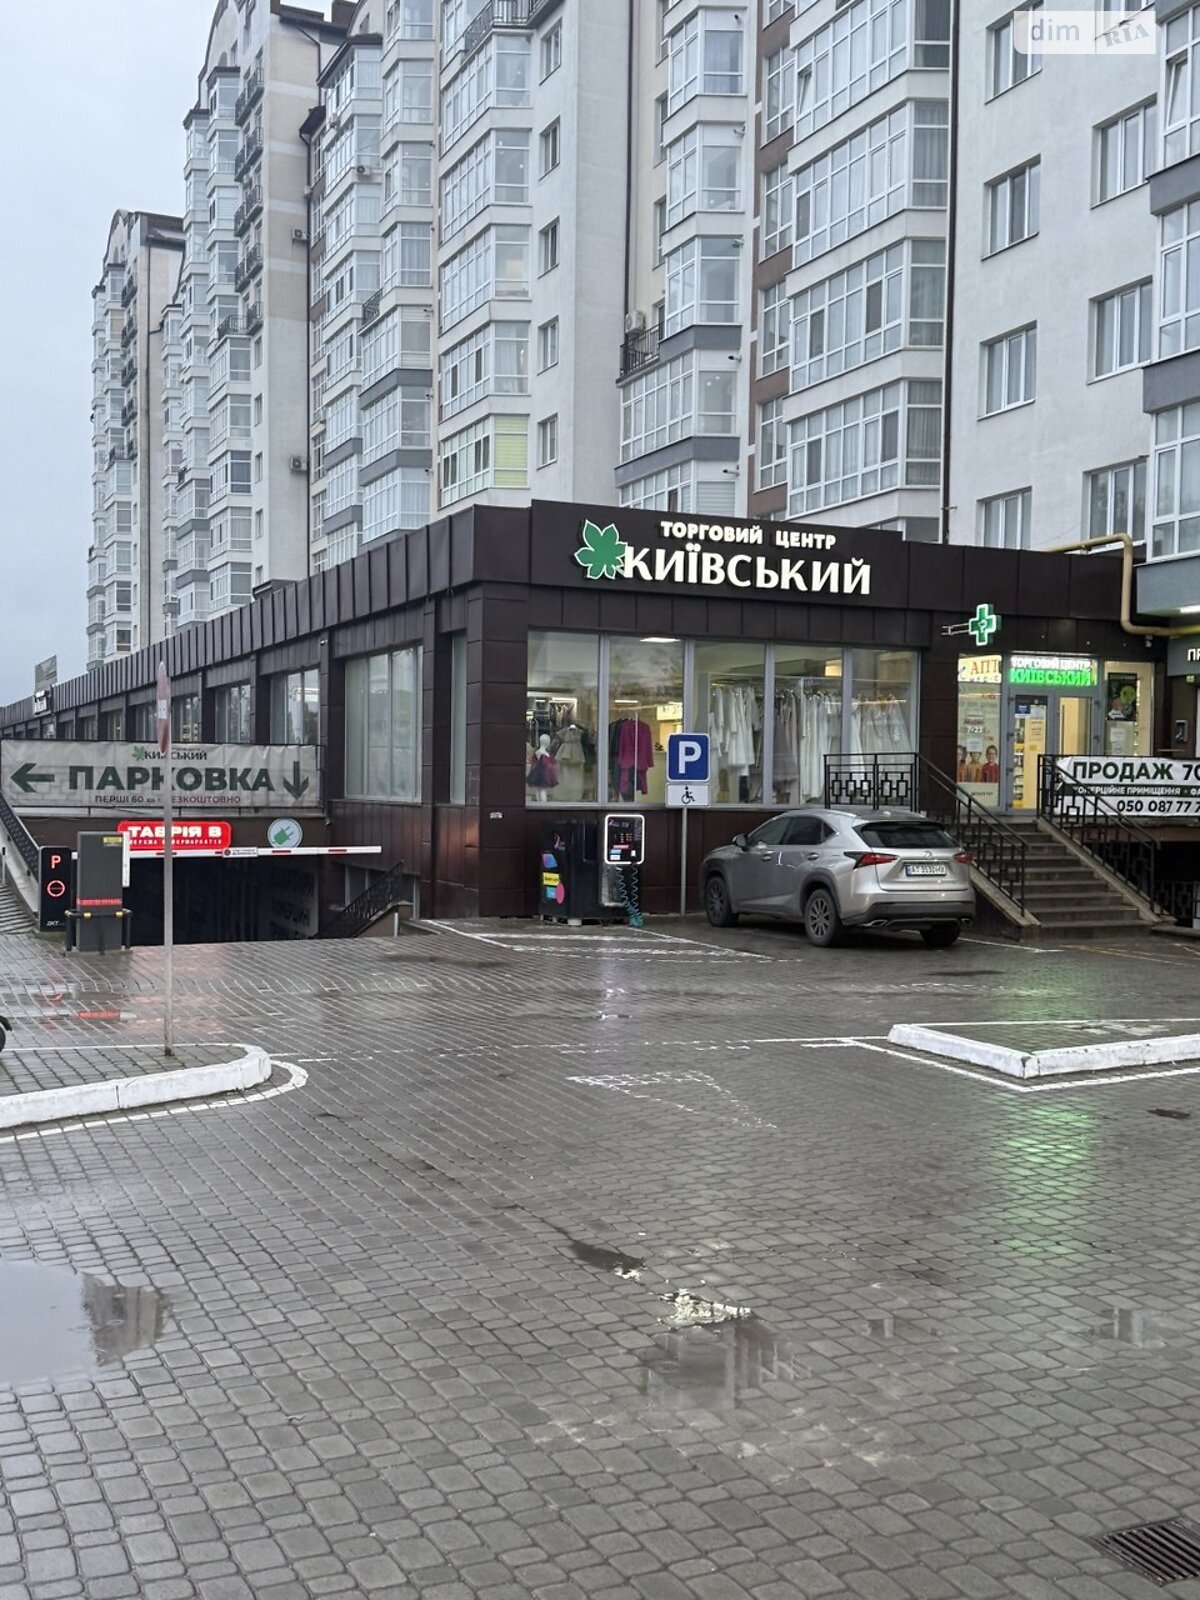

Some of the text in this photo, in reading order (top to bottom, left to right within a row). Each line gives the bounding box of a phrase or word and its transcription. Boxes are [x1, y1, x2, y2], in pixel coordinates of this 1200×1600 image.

[661, 521, 836, 550] ТОРГОВИЙ ЦЕНТР
[622, 542, 871, 595] КИЇВСЬКИЙ
[1010, 668, 1091, 686] КИЇВСЬКИЙ
[678, 741, 702, 774] P
[1073, 761, 1173, 782] ПРОДАЖ
[95, 795, 129, 804] ПЕРШІ
[131, 795, 144, 803] 60
[171, 796, 241, 804] ЕЗКОШТОВНО
[1126, 787, 1180, 796] ПРИМІЩЕННЯ
[1116, 800, 1143, 812] 050
[1148, 801, 1173, 813] 087
[1176, 801, 1192, 813] 77
[128, 826, 222, 838] ТАВРІЯ В
[51, 854, 61, 869] P
